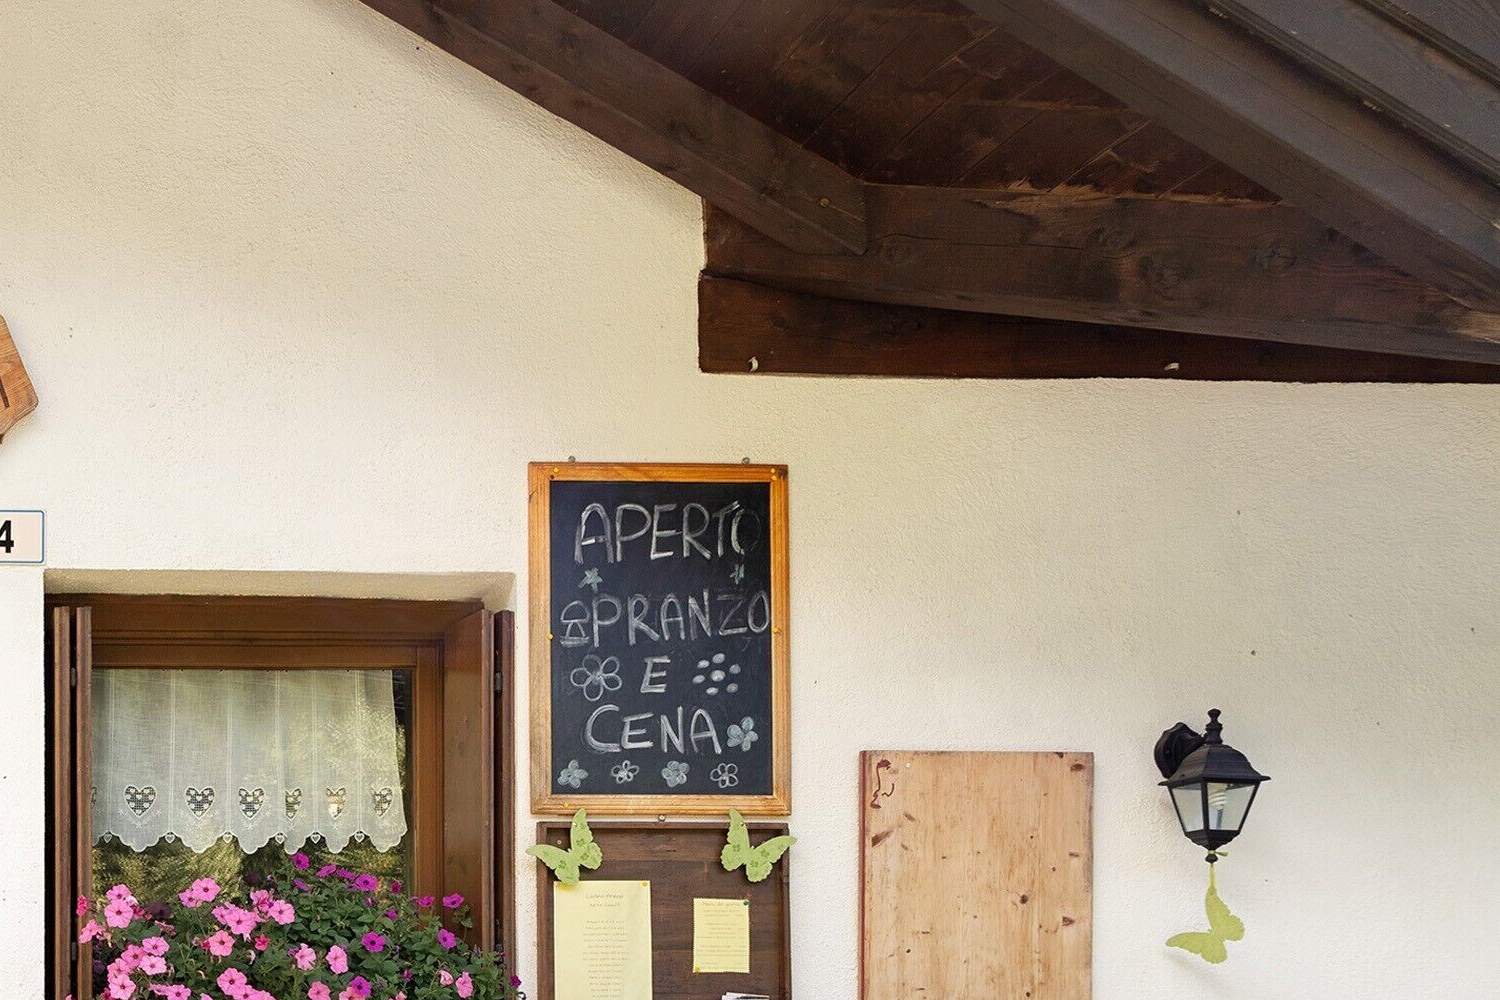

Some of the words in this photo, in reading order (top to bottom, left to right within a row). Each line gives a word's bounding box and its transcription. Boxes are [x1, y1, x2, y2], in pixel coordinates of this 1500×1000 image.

[592, 589, 770, 648] PRANZO
[640, 655, 671, 693] E
[583, 704, 722, 755] CENA
